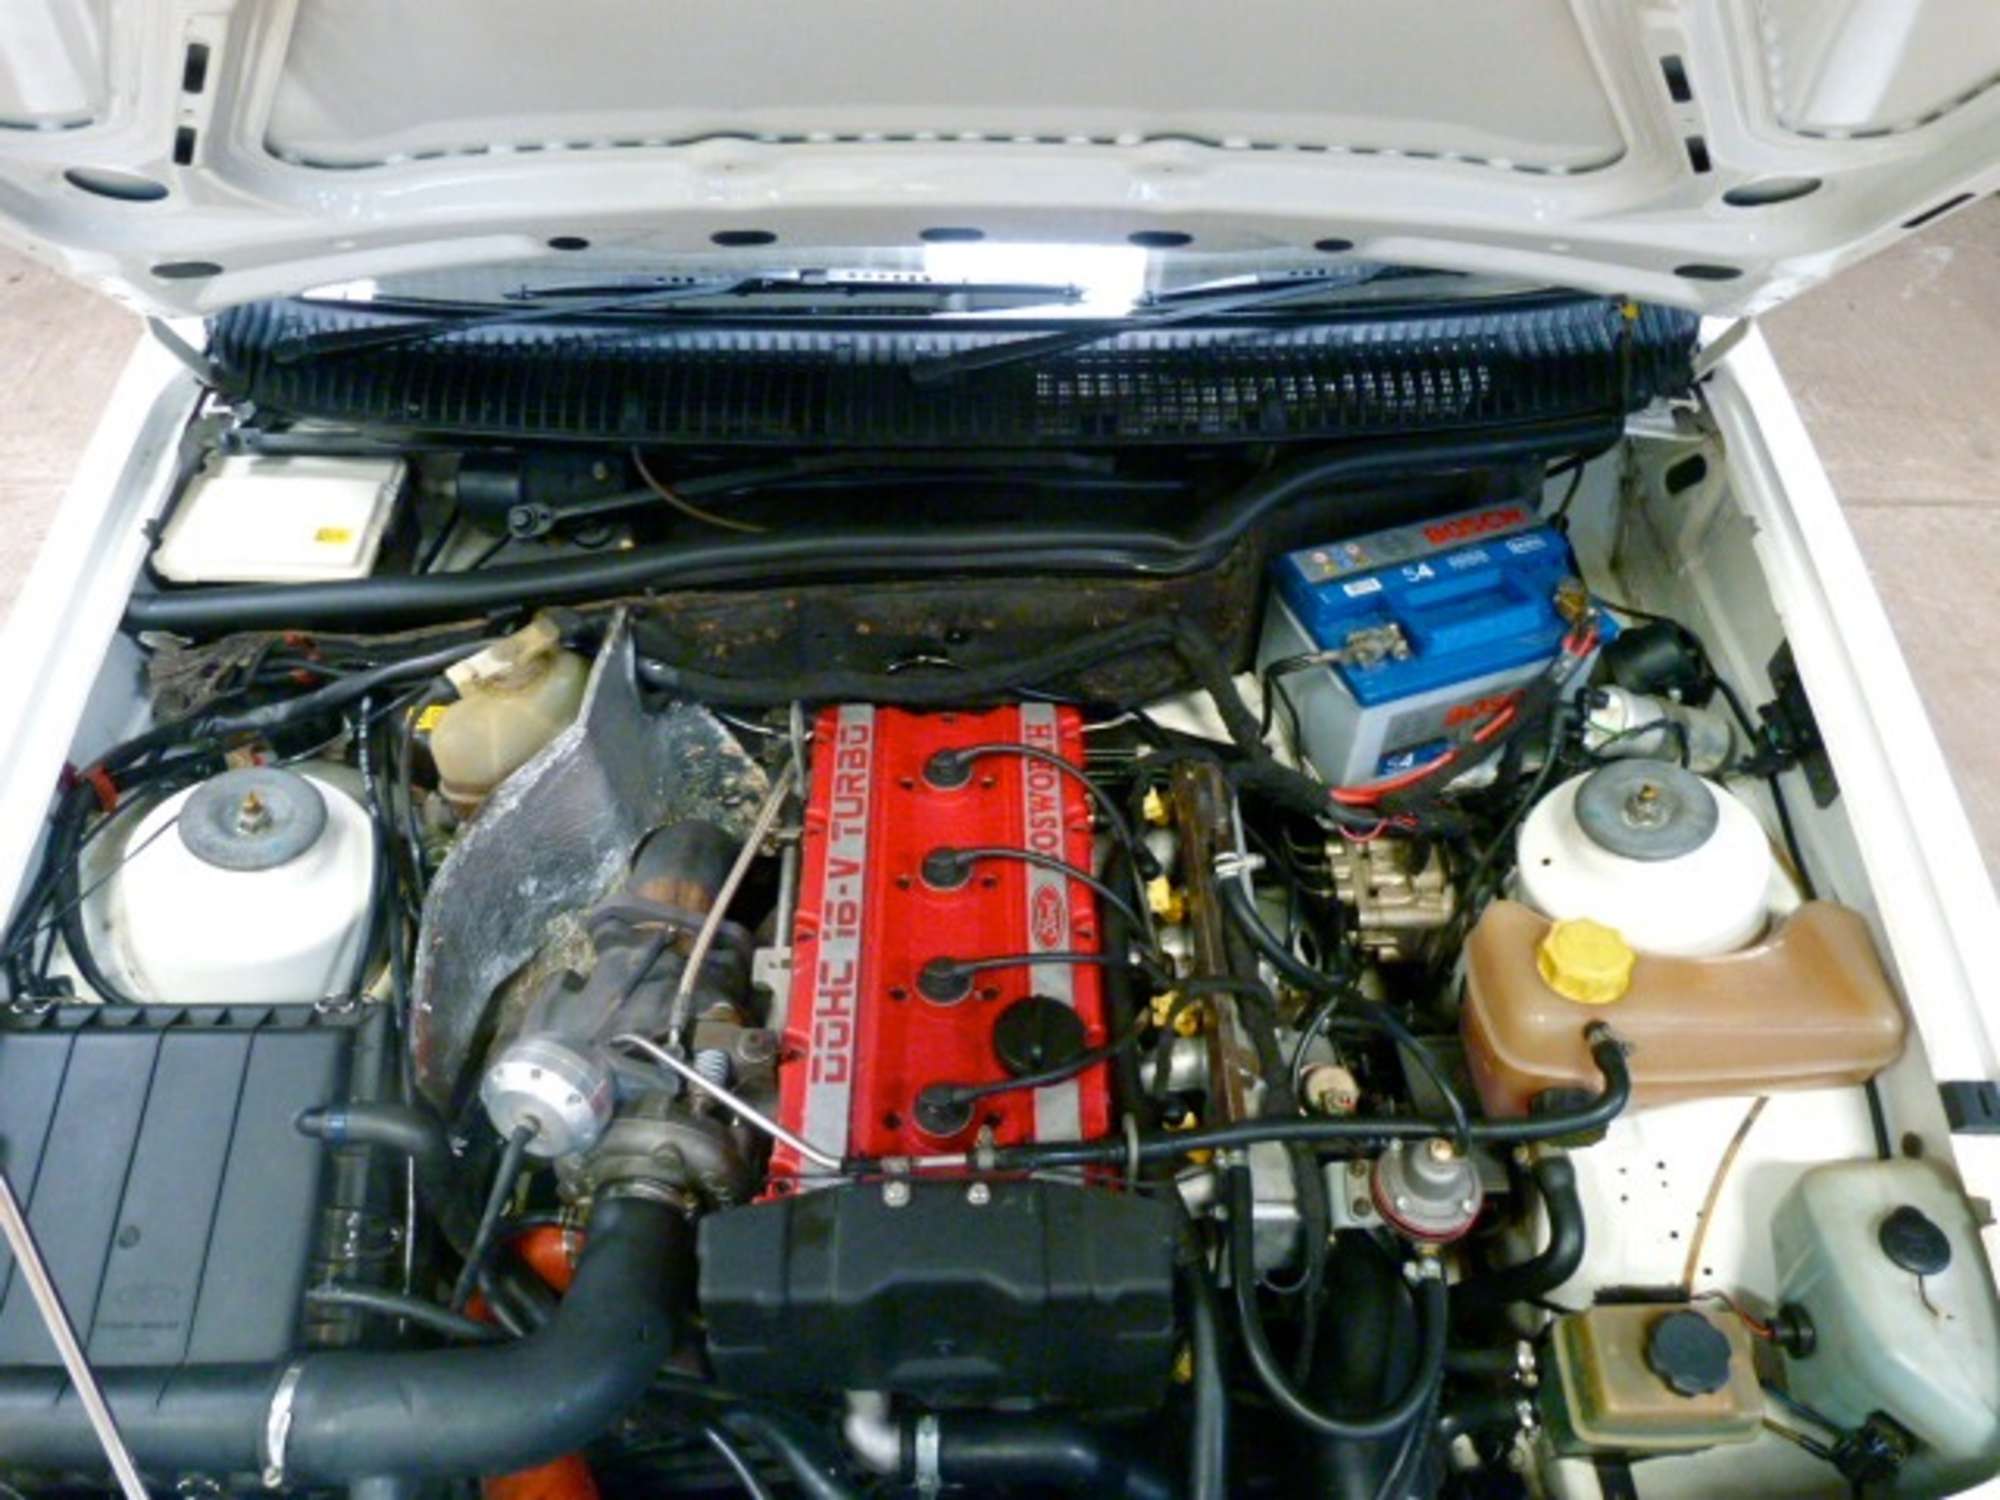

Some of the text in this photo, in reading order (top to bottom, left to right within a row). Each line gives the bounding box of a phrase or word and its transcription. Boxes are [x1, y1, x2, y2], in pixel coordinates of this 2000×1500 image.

[812, 724, 869, 1083] DOHC 16-V TURBO
[1026, 724, 1059, 867] OSWORH
